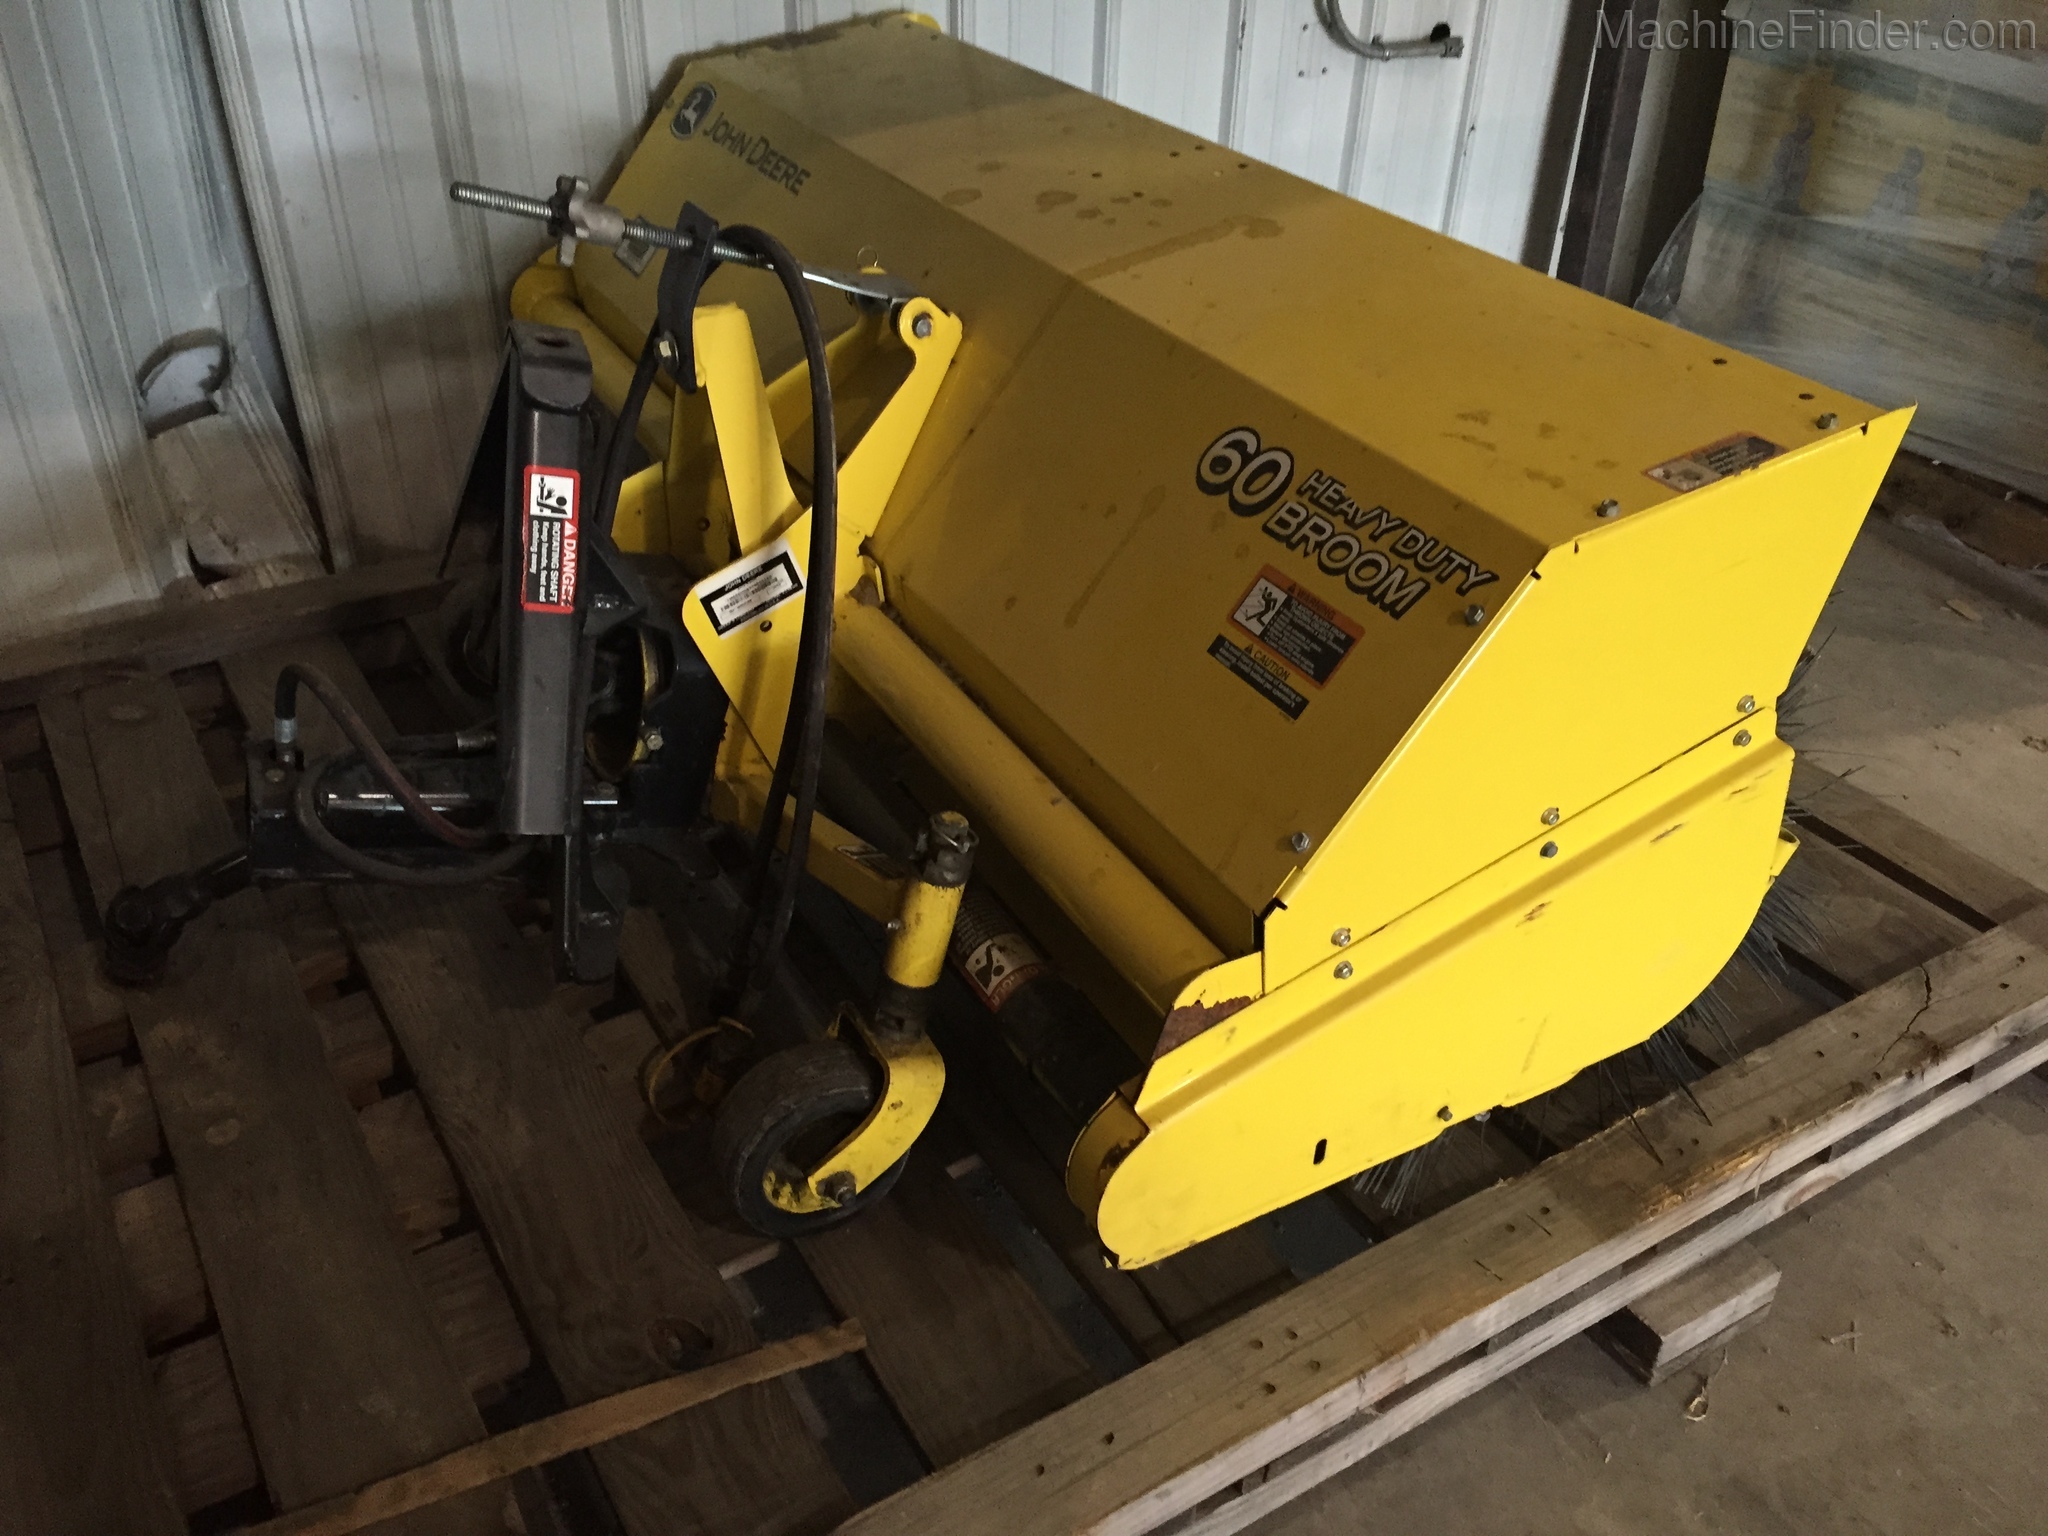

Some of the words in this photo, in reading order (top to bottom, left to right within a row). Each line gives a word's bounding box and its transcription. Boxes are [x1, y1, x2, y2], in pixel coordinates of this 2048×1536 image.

[702, 111, 752, 158] JOHN
[746, 135, 812, 196] DEERE
[1195, 426, 1295, 518] 60
[551, 522, 561, 569] ROTATING
[1261, 500, 1431, 620] BROOM
[1296, 469, 1409, 543] HEAVY
[1389, 525, 1499, 597] DUTY
[549, 570, 560, 603] SHAFT
[1254, 650, 1290, 681] CAUTION
